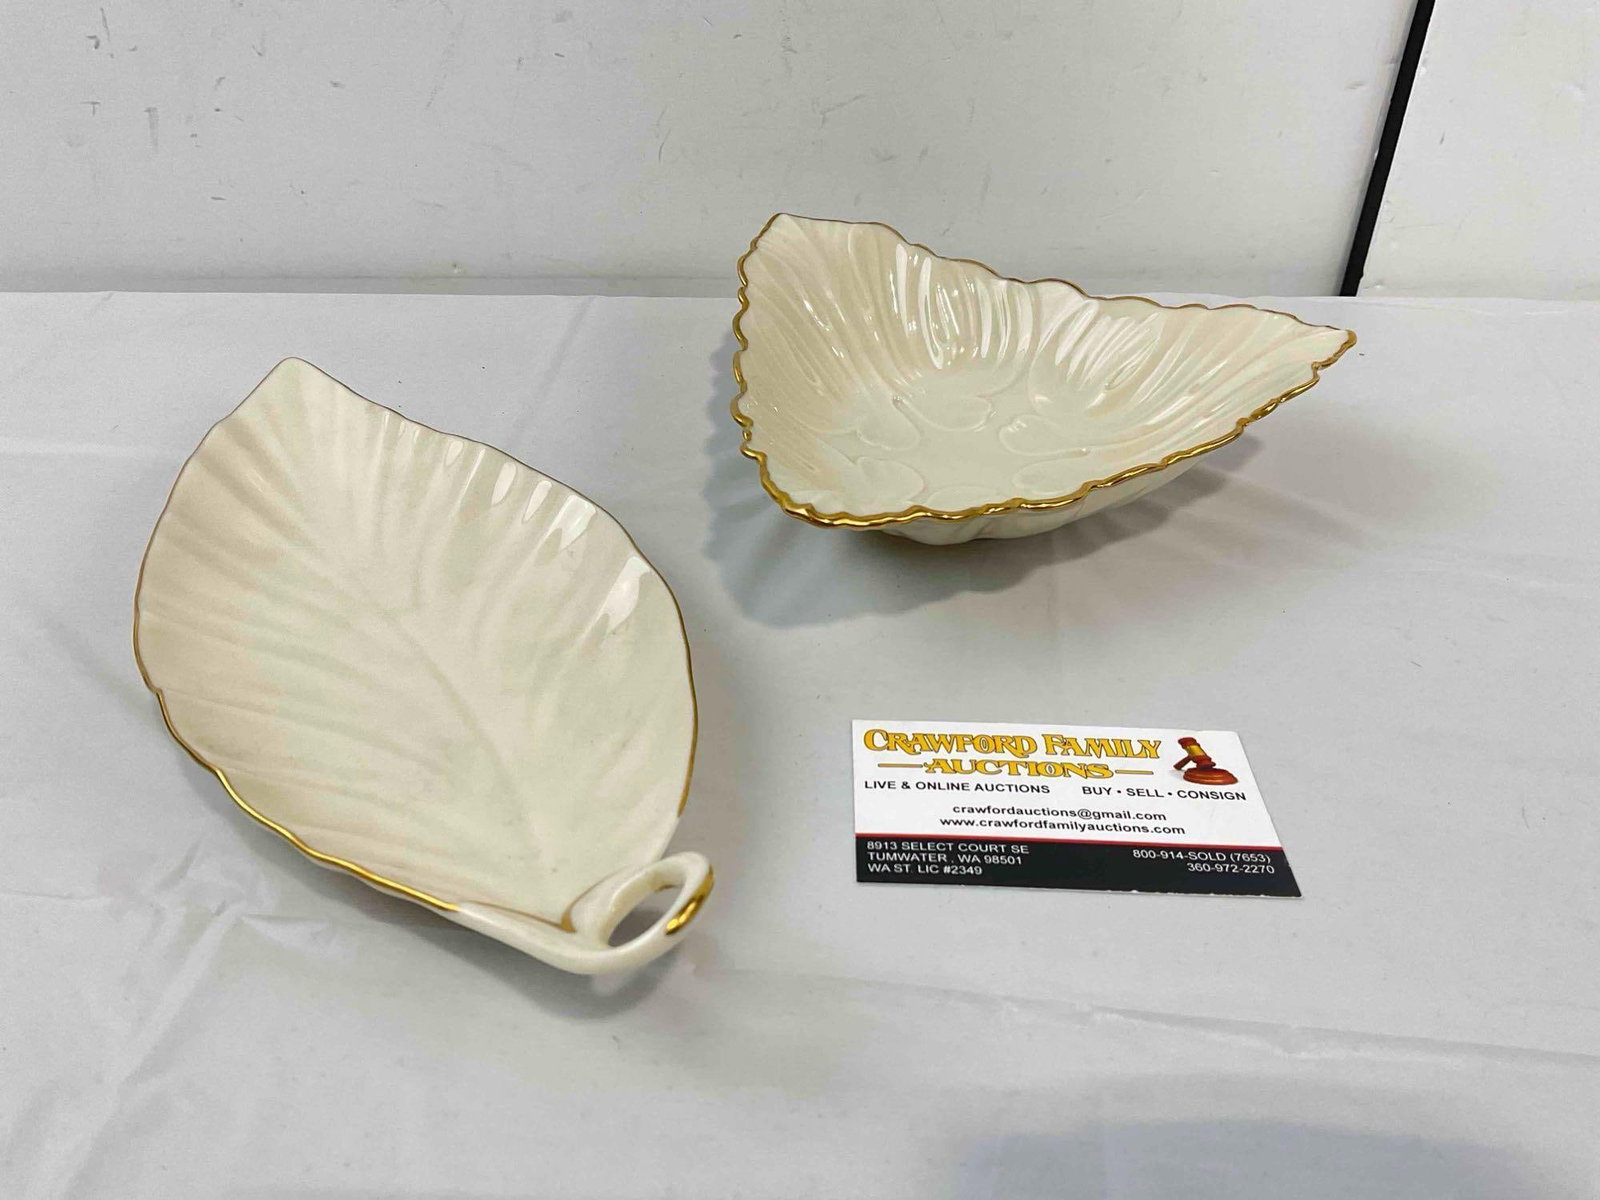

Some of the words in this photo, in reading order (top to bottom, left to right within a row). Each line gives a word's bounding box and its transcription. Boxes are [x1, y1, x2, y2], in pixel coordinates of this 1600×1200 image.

[864, 729, 1037, 757] CRAWFORD
[1042, 733, 1161, 759] FAMILY
[924, 758, 1114, 779] AUCTIONS
[865, 780, 896, 789] LIVE
[901, 781, 911, 790] &
[915, 781, 970, 792] ONLINE
[974, 783, 1050, 794] AUCTIONS
[1082, 786, 1112, 796] BUY
[1126, 787, 1164, 798] SELL
[1177, 789, 1247, 801] CONSIGN
[952, 804, 1167, 821] crawfordauctions@gmail.com
[940, 816, 1185, 835] www.crawfordfamilyauctions.com
[867, 841, 898, 850] 8913
[901, 841, 953, 852] SELECT
[958, 843, 1006, 854] COURT
[1010, 844, 1029, 855] SE
[957, 854, 981, 864] WA
[983, 855, 1022, 865] 98501
[1133, 849, 1226, 862] 800-914-SOLD
[1230, 852, 1271, 864] (7653)
[867, 863, 891, 873] WA
[917, 864, 939, 874] LIC
[943, 865, 983, 875] #2349
[1186, 862, 1275, 874] 360-972-2270
